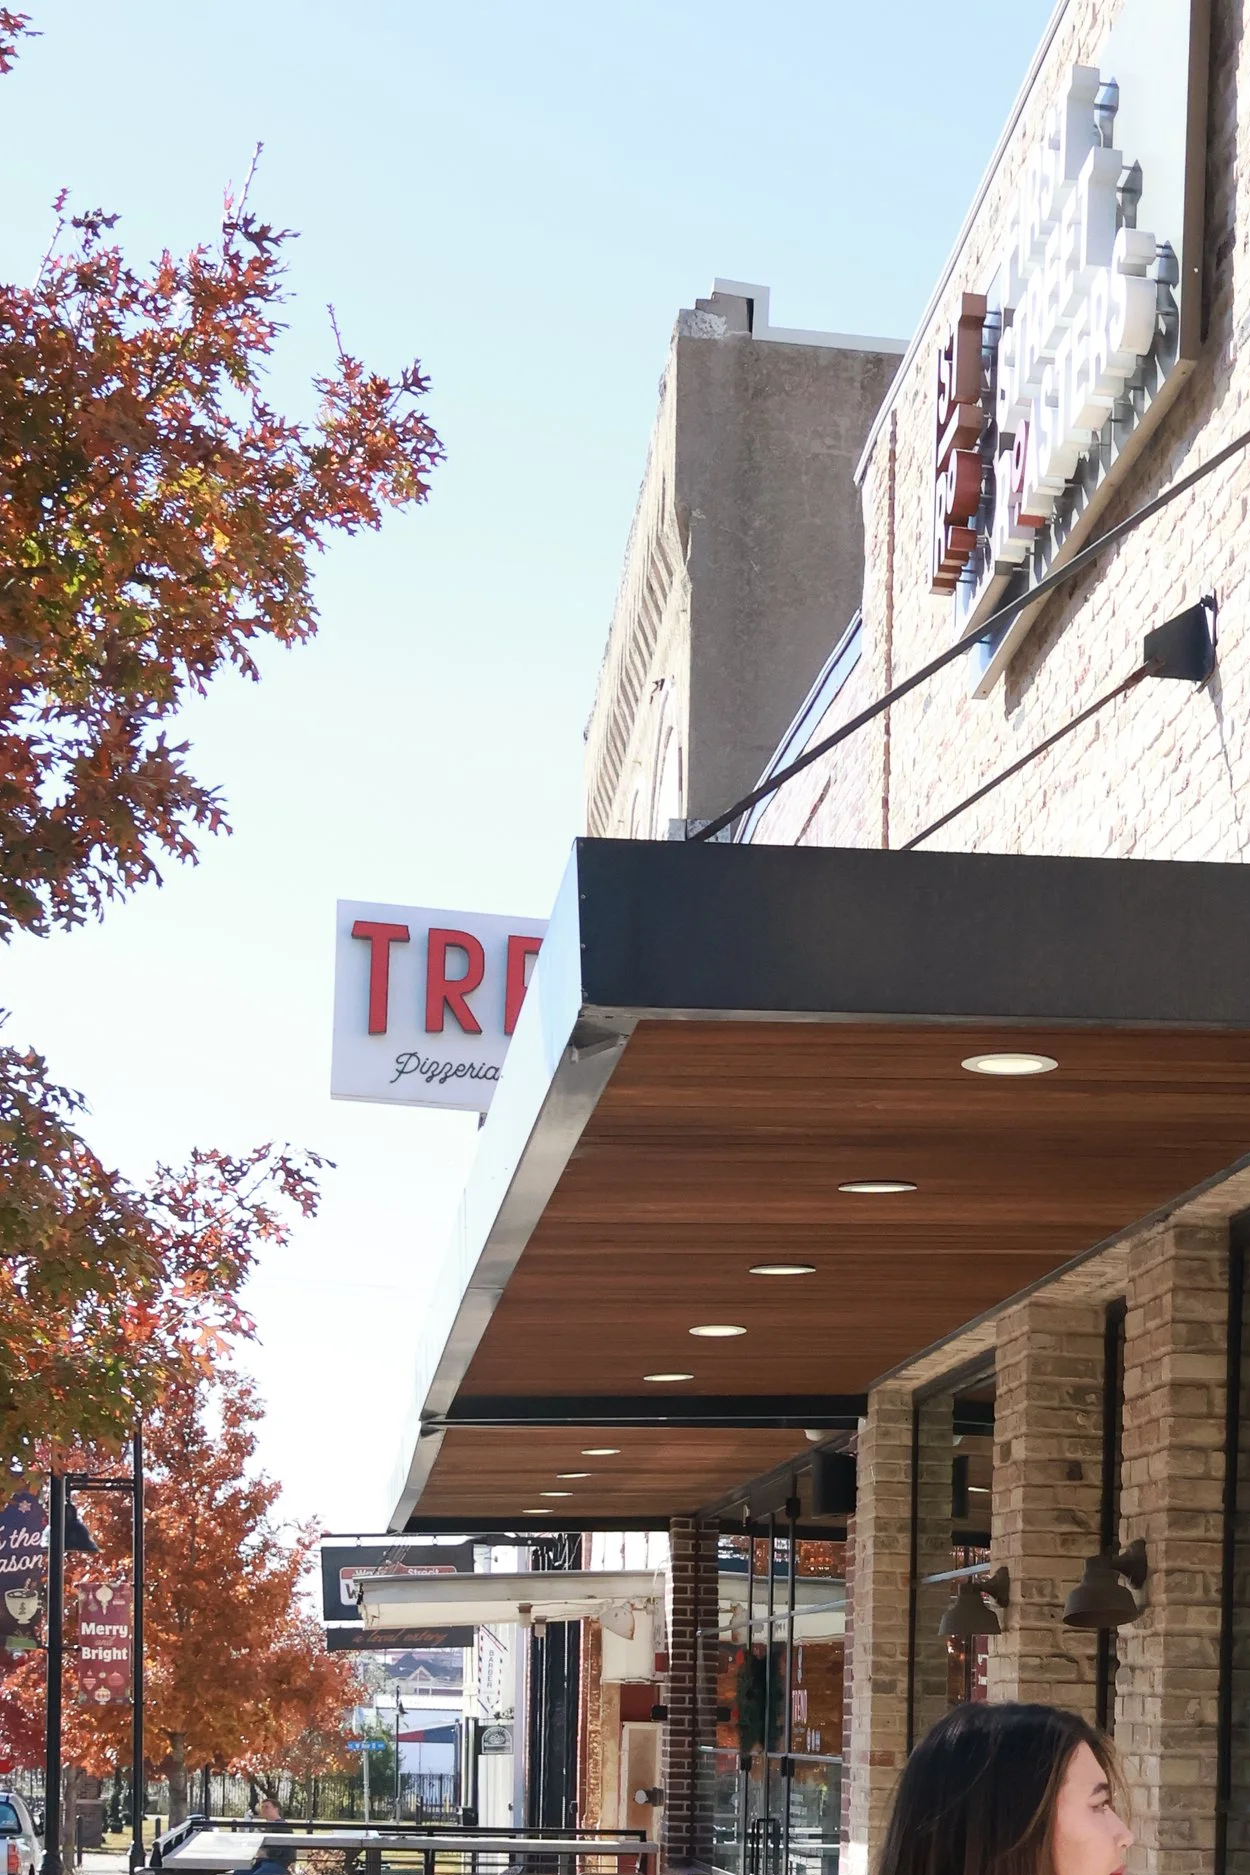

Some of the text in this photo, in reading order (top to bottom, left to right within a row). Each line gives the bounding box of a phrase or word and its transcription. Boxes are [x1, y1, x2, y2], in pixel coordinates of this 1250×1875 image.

[998, 64, 1095, 304] FIRST
[996, 147, 1112, 432] STREET
[993, 228, 1145, 560] ROASTERS
[389, 1051, 501, 1085] Pizzeria
[9, 1526, 41, 1549] the
[81, 1622, 129, 1638] Merry
[81, 1646, 129, 1662] Bright
